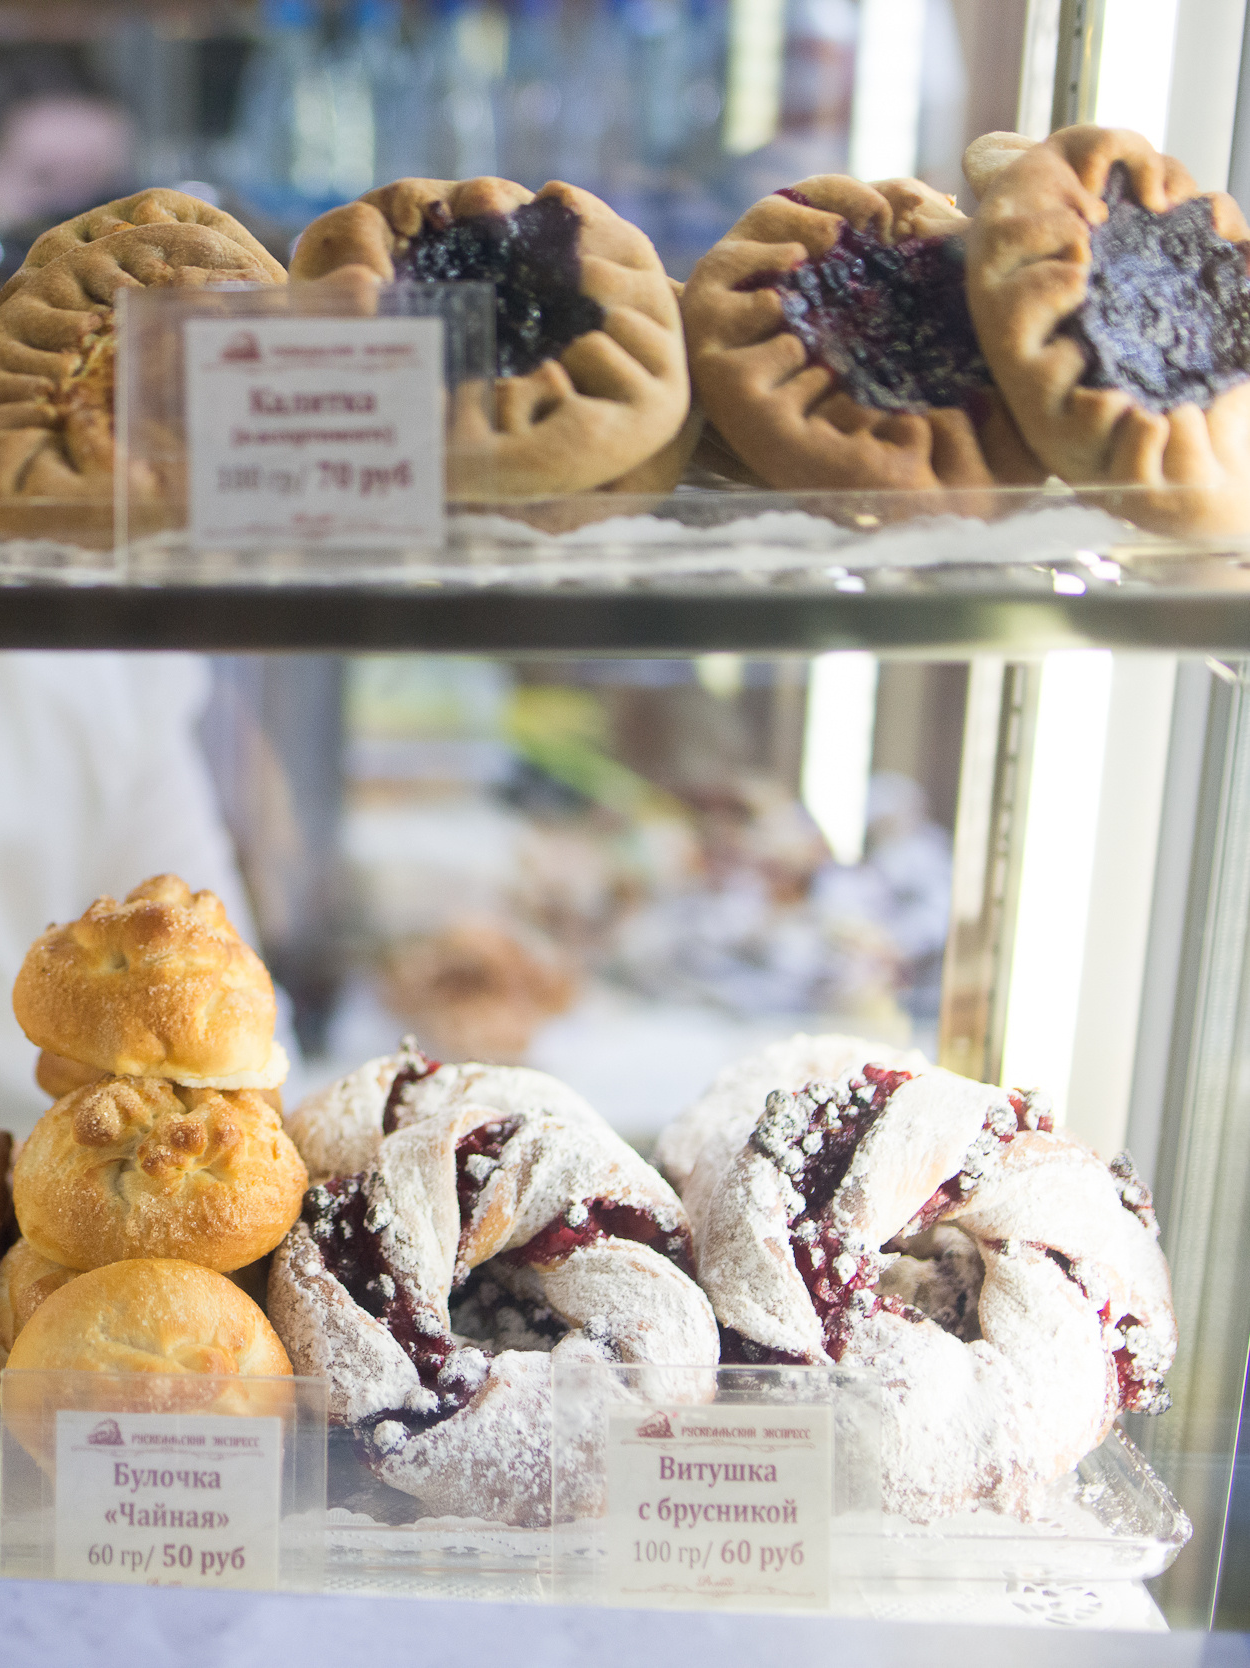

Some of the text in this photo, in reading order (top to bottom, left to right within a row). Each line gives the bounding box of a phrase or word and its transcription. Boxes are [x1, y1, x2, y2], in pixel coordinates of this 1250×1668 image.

[316, 460, 353, 490] 70
[360, 460, 413, 498] руб
[762, 1427, 811, 1439] ЭКСПРЕСС
[114, 1462, 221, 1493] Булочка
[659, 1455, 777, 1488] Витушка
[104, 1502, 229, 1529] «Чайная»
[638, 1497, 798, 1529] с брусникой
[88, 1543, 245, 1576] 60 гр/ 50 руб
[634, 1539, 805, 1572] 100 гр/ 60 руб
